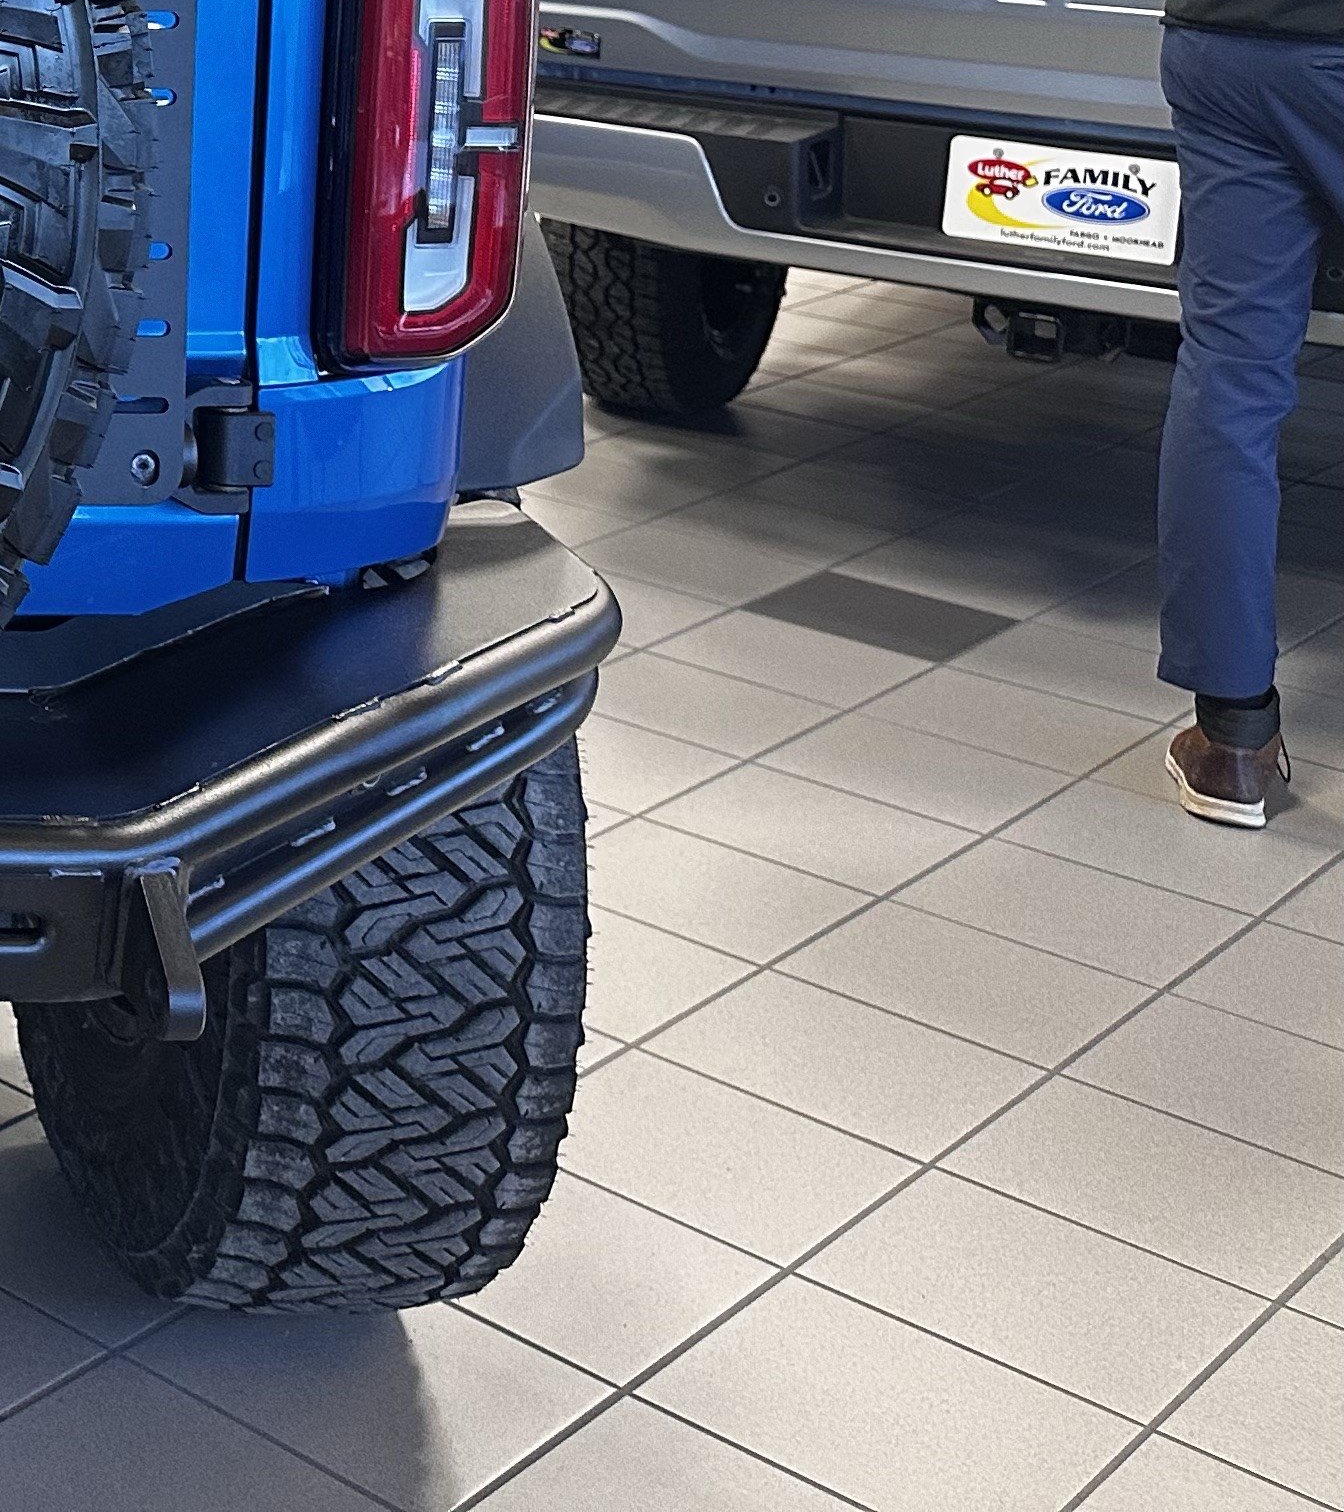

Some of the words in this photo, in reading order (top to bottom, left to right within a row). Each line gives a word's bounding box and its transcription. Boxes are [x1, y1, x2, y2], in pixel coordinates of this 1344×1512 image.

[976, 161, 1026, 181] Luther
[1043, 167, 1157, 198] FAMILY
[1062, 190, 1128, 220] Ford
